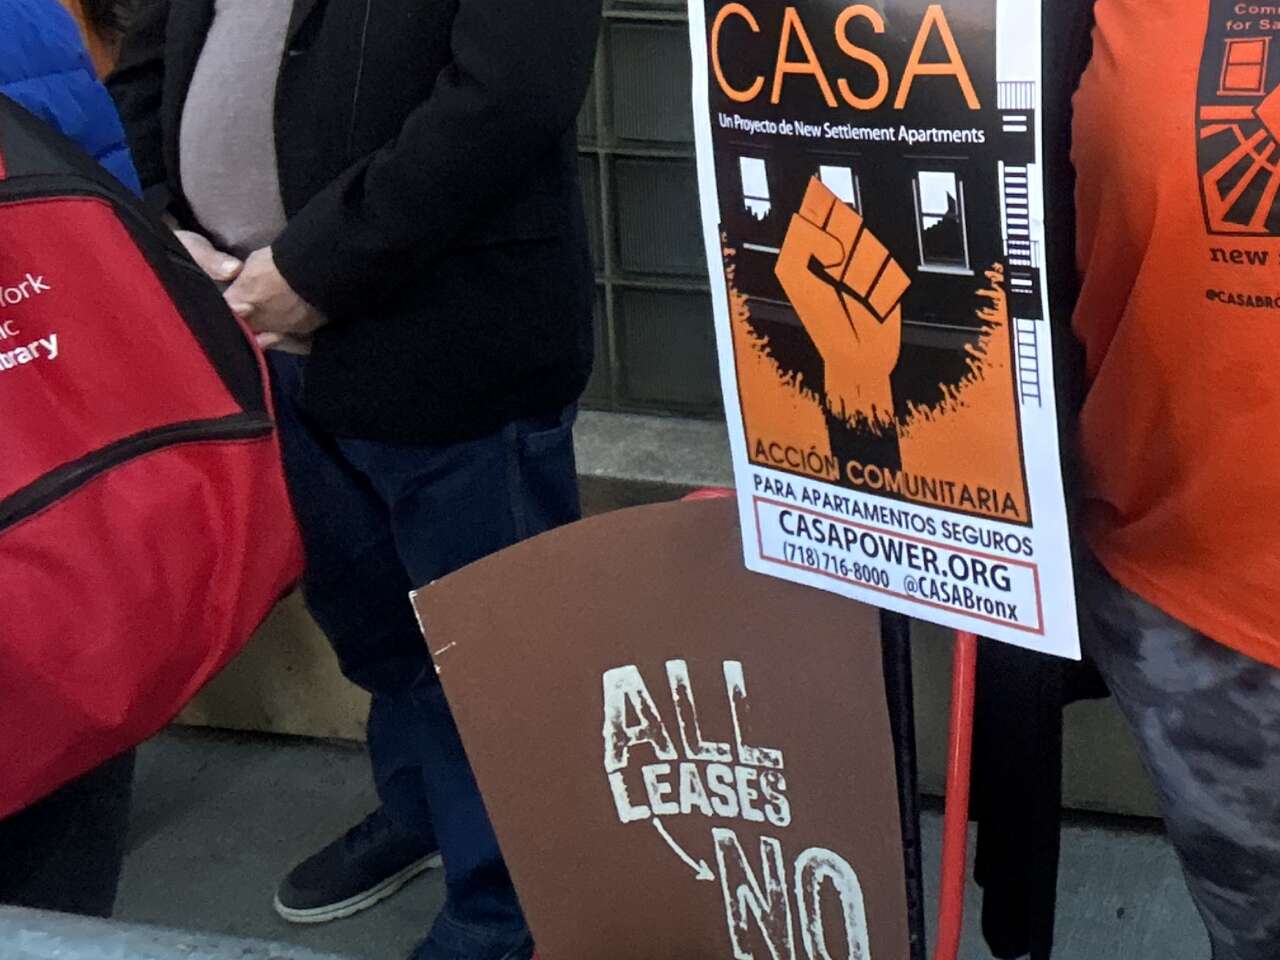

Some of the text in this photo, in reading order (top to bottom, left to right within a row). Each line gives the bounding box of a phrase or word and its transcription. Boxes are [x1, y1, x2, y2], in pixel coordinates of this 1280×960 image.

[711, 2, 980, 110] CASA
[1226, 20, 1250, 31] for
[718, 113, 985, 144] Un Proyecto de New Settlement Apartments
[1210, 247, 1268, 265] new
[753, 473, 1033, 556] PARA APARTAMENTOS SEGUROS
[754, 439, 1020, 517] ACCIÓN COMUNITARIA
[779, 509, 1011, 592] CASAPOWER.ORG
[904, 574, 1018, 621] @CASABronx
[602, 659, 784, 774] ALL
[608, 762, 791, 827] LEASES
[712, 827, 871, 960] NO
